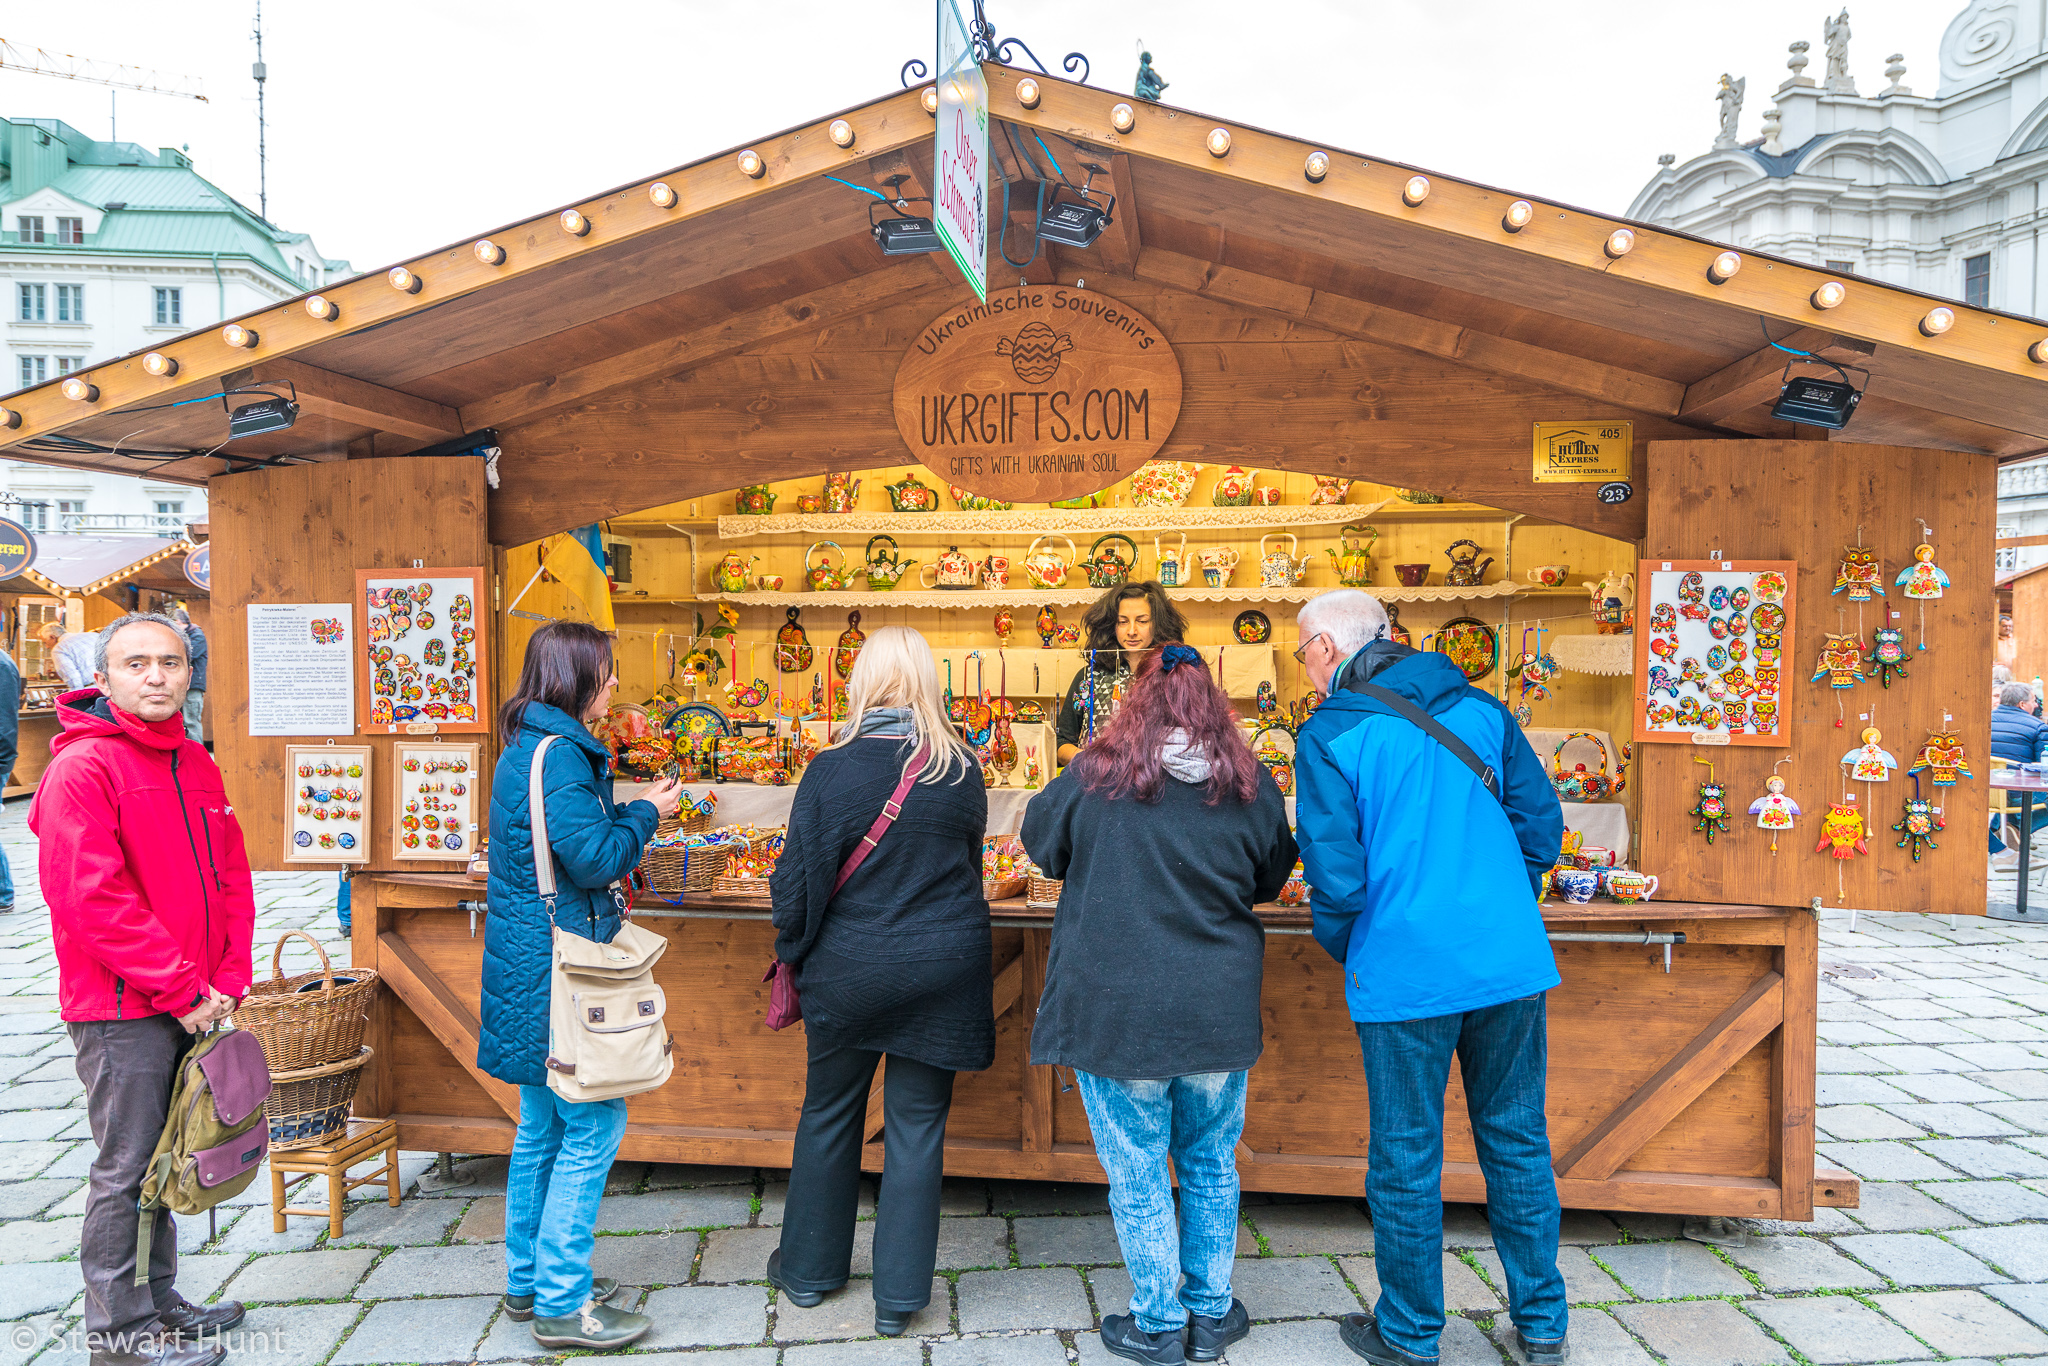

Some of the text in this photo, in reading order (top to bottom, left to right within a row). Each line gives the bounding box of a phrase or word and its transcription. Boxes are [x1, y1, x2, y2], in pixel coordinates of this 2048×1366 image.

[956, 109, 977, 186] Oster
[940, 150, 976, 268] Schmuck
[917, 290, 1155, 355] Ukrainische Souvenirs
[921, 388, 1150, 446] UKRGIFTS.COM
[1600, 429, 1620, 438] 405
[950, 453, 1121, 476] GIFTS WITH UKRAINIAN SOUL
[1605, 488, 1625, 502] 23
